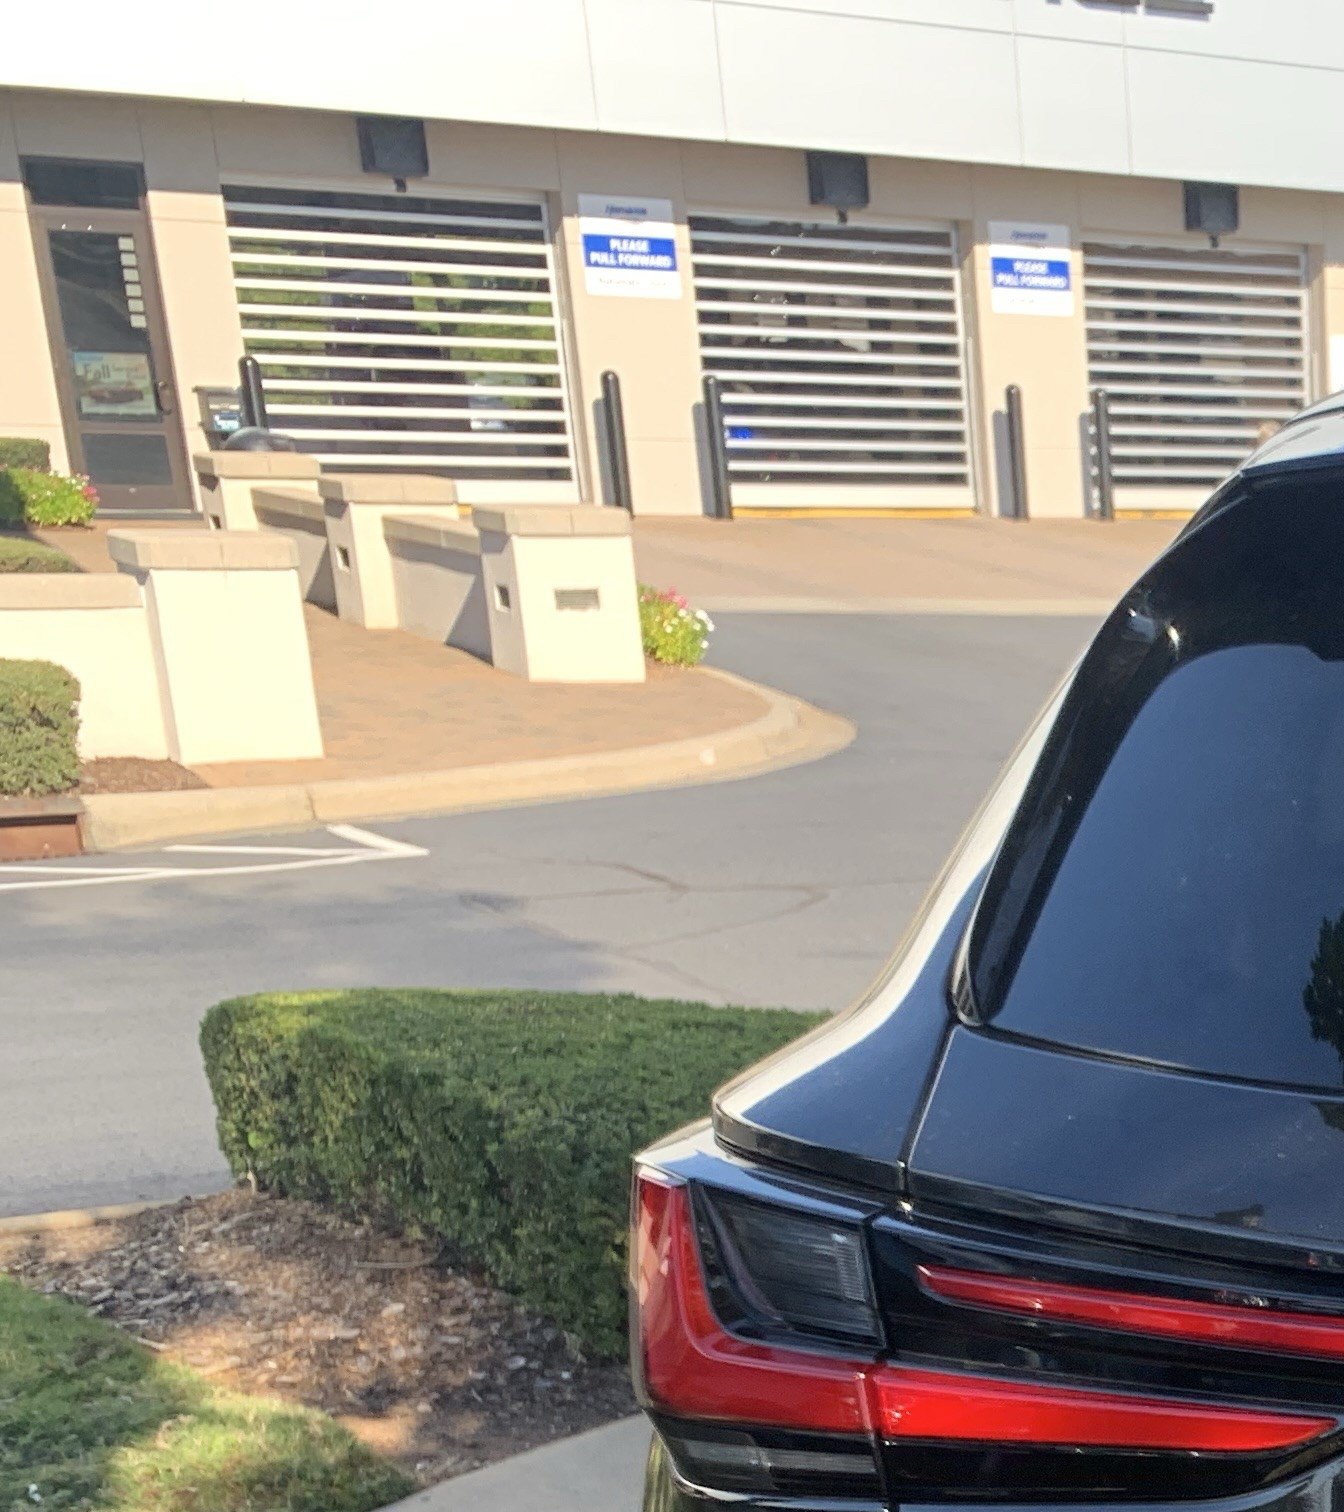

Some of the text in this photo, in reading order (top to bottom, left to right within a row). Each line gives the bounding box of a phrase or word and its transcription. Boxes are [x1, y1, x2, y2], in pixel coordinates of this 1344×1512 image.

[609, 238, 649, 253] PLEASE
[589, 250, 672, 269] PULL FORWARD
